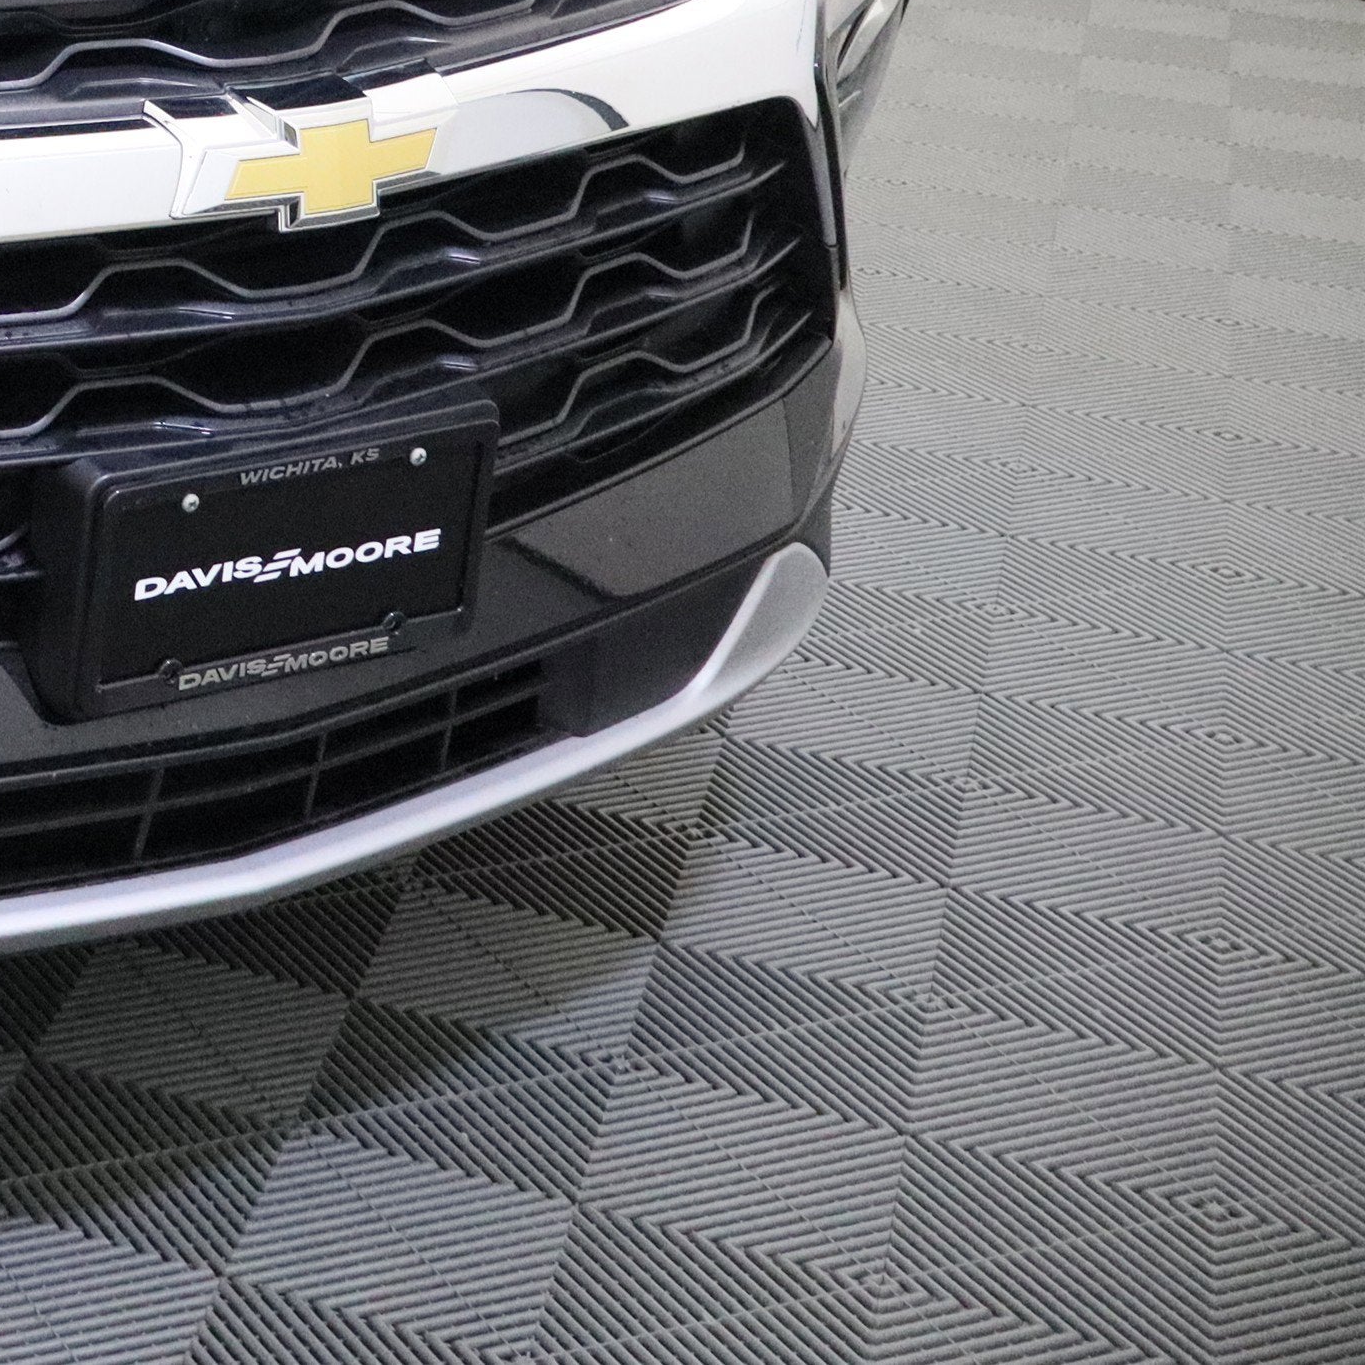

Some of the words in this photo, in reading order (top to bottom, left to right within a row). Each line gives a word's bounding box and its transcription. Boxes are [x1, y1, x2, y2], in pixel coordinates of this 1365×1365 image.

[240, 455, 343, 486] WICHITA,
[350, 447, 380, 466] KS
[134, 555, 264, 601] DAVIS
[288, 528, 442, 577] MOORE
[178, 659, 267, 691] DAVIS
[283, 636, 390, 673] MOORE
